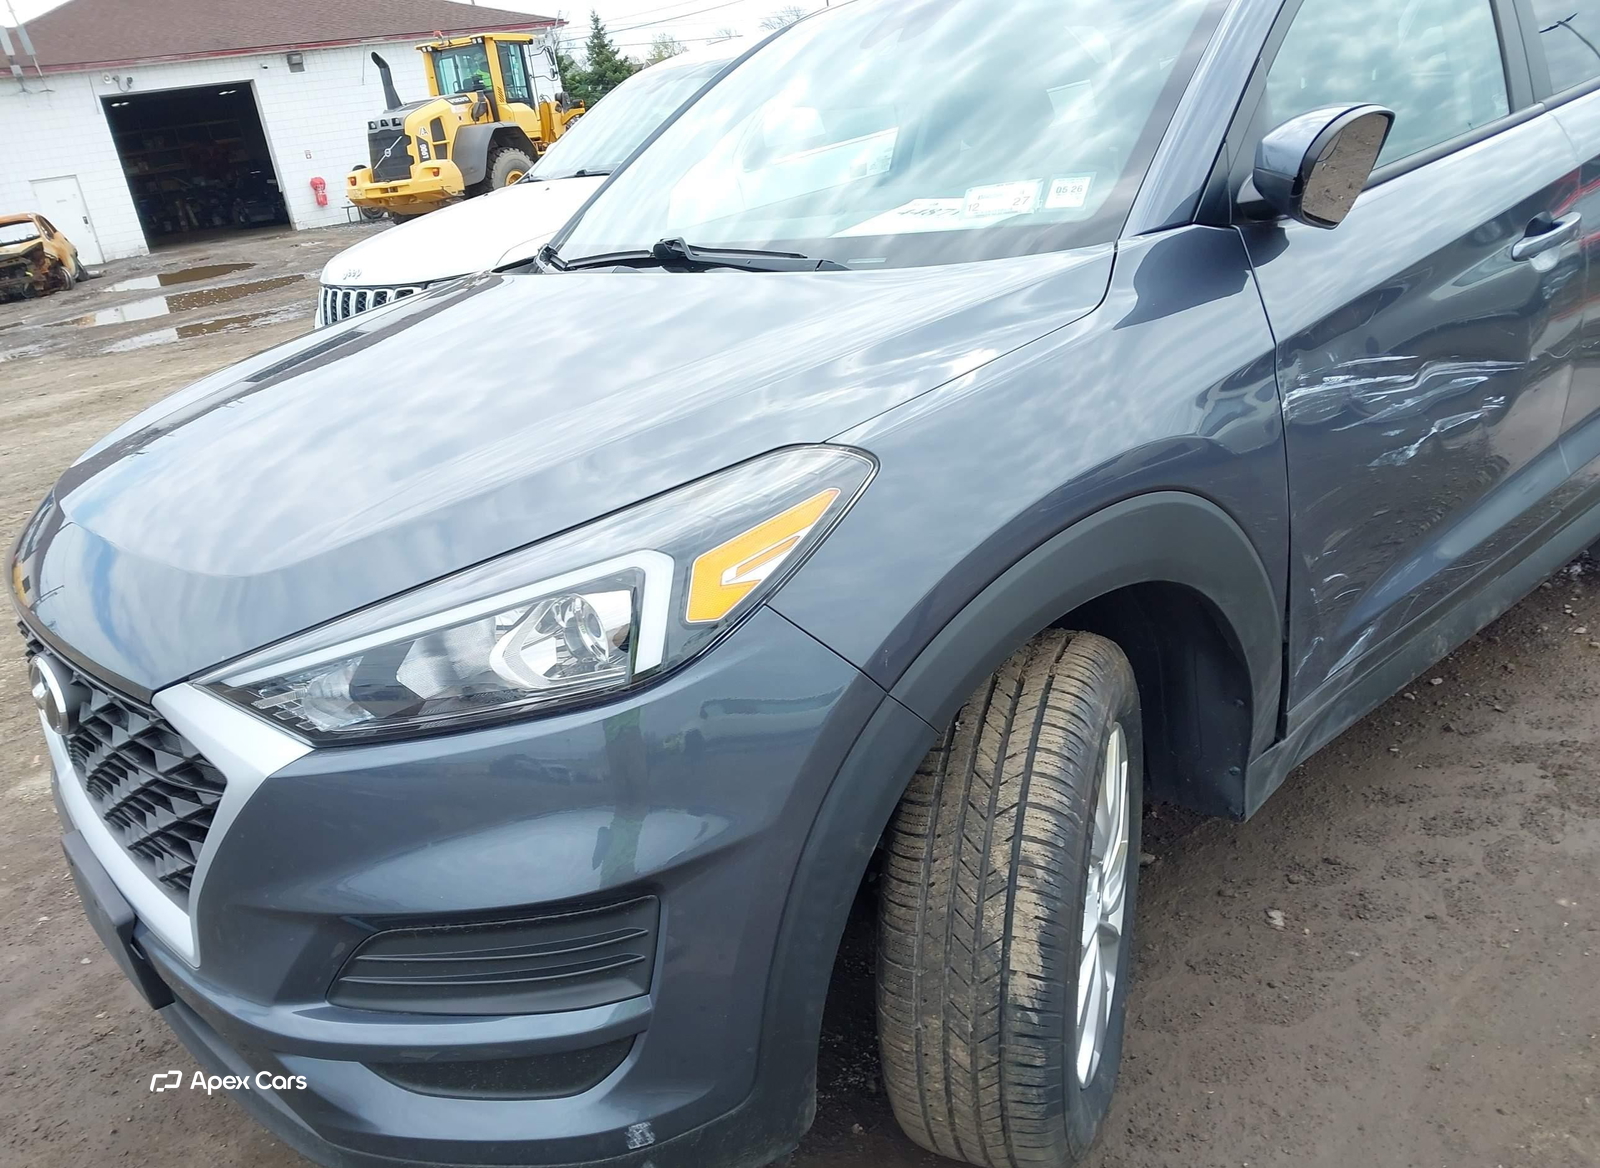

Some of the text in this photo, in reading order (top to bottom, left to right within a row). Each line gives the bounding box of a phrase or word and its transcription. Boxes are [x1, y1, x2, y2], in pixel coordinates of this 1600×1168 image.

[1055, 184, 1083, 194] 05 26
[1012, 195, 1031, 206] 27
[967, 202, 980, 212] 12
[342, 268, 363, 281] Jeep
